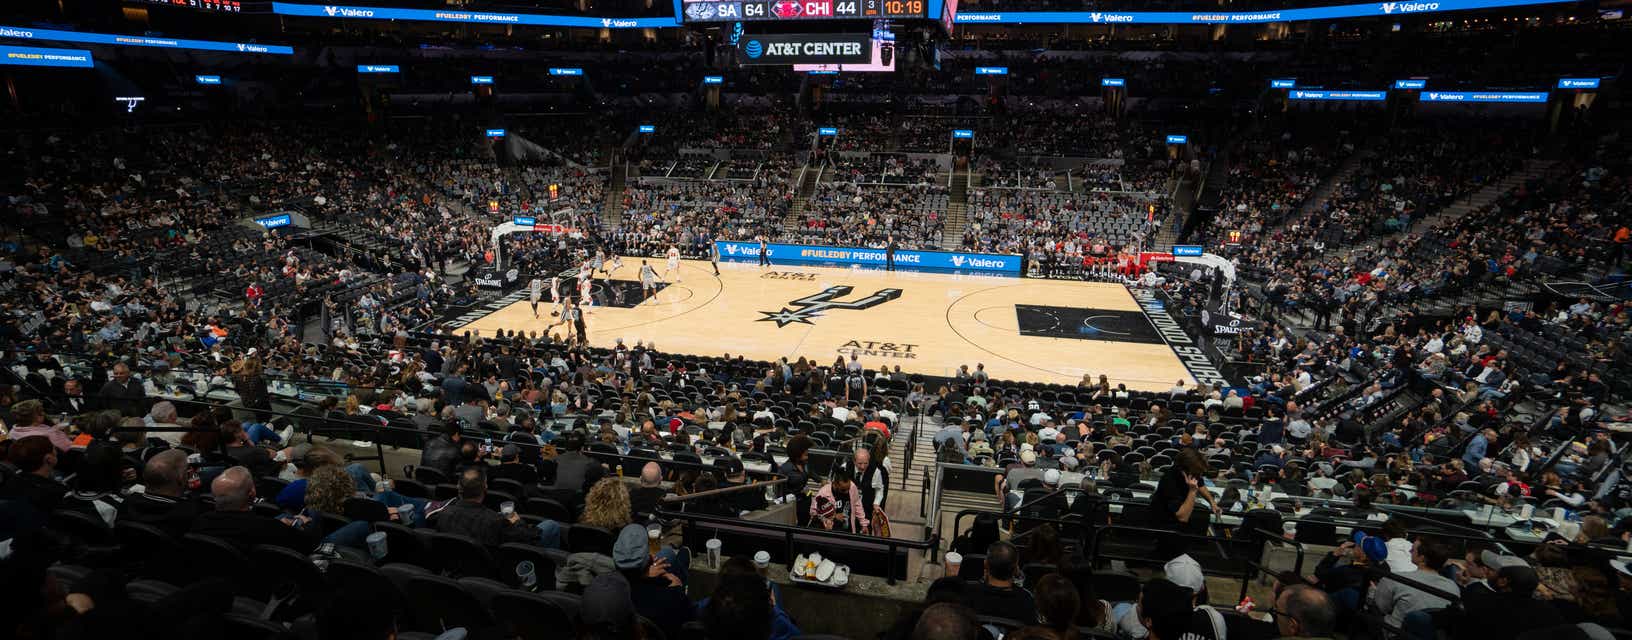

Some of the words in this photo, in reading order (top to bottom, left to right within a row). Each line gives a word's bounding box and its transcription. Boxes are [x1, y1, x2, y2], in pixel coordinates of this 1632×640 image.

[718, 3, 737, 17] SA
[745, 4, 764, 16] 64
[805, 2, 830, 15] CHI
[836, 2, 856, 14] 44
[868, 0, 875, 9] 3
[885, 1, 922, 14] 10:19
[1400, 2, 1439, 12] Valero
[341, 8, 373, 17] Valero
[474, 14, 518, 22] PERFORMANCE
[1103, 14, 1133, 22] Valero
[766, 43, 801, 55] AT&T
[803, 42, 861, 55] CENTER
[741, 246, 773, 256] Valeo
[801, 249, 850, 260] #FUELEDBY
[968, 257, 1004, 268] Valero
[474, 278, 501, 287] SPALDING
[1214, 325, 1254, 333] SPALD
[840, 340, 919, 352] AT&T
[1173, 345, 1231, 388] SPURS
